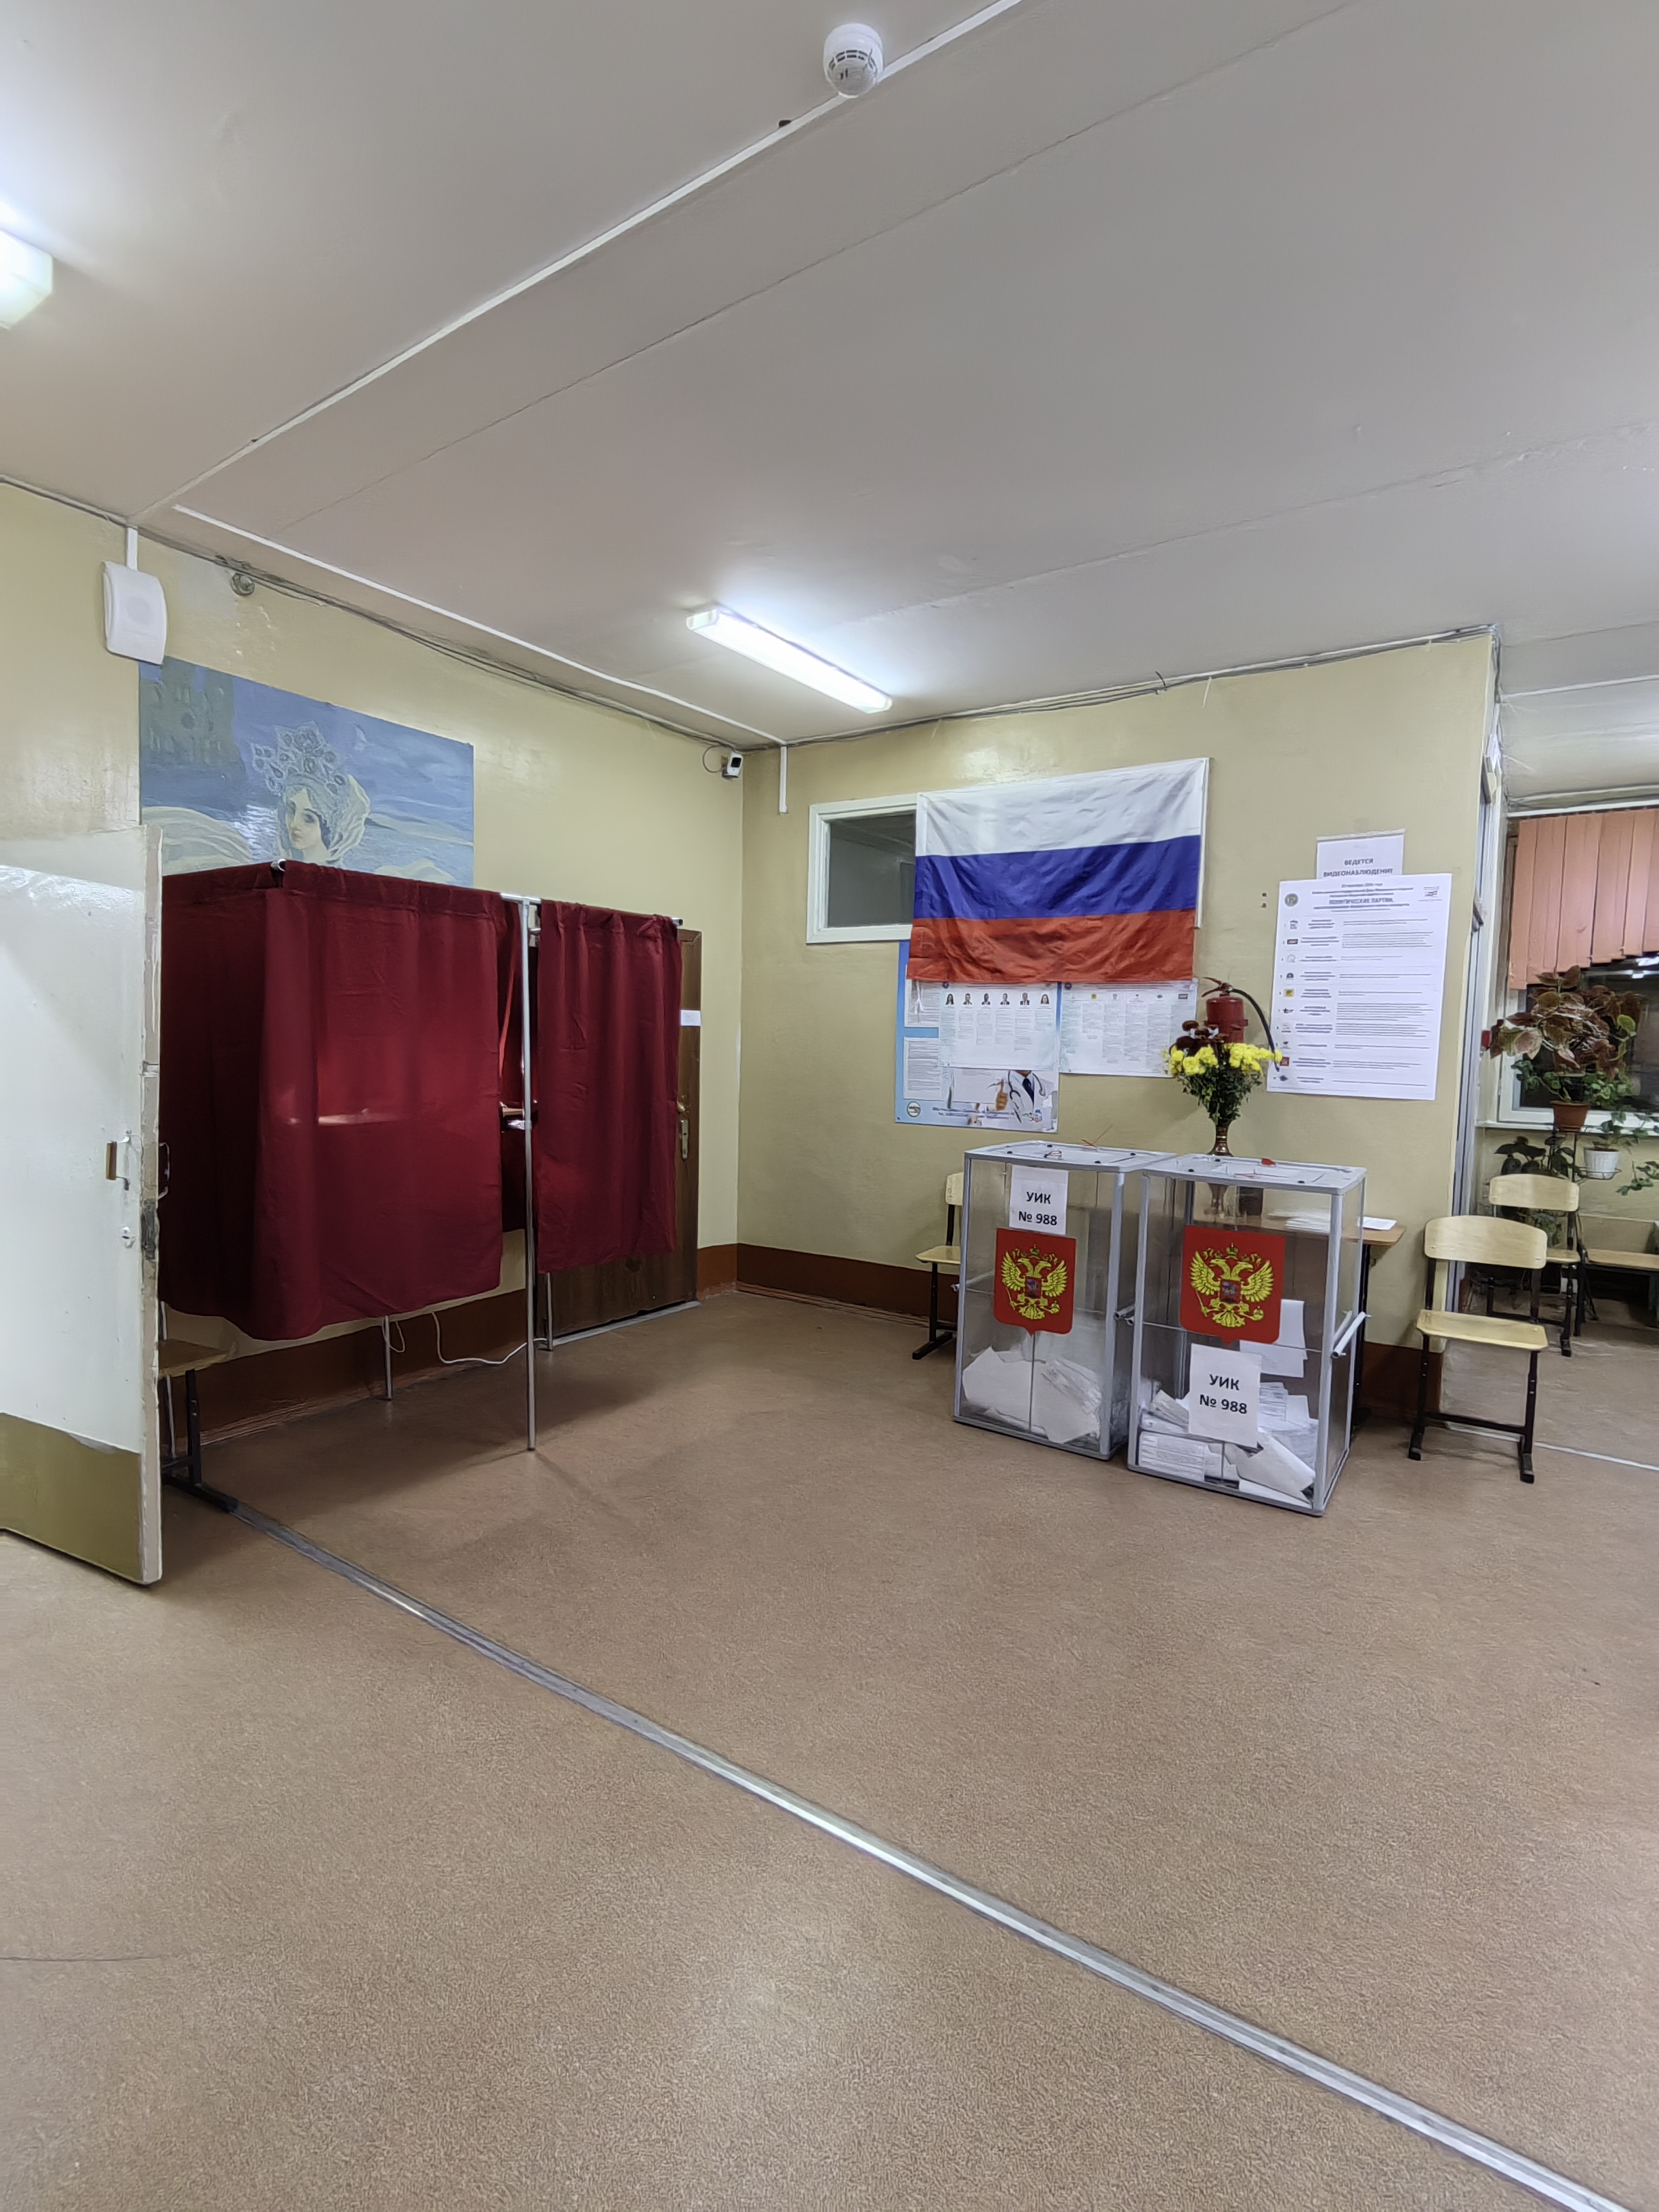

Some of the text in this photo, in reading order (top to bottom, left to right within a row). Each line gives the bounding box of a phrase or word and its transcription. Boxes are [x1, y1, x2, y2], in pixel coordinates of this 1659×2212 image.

[1323, 867, 1393, 877] ВИДЕОНАБЛЮДЕНИЕ
[1026, 1191, 1051, 1204] УИК
[1018, 1210, 1058, 1226] № 988
[1208, 1374, 1240, 1391] УИК
[1200, 1394, 1248, 1414] № 988
